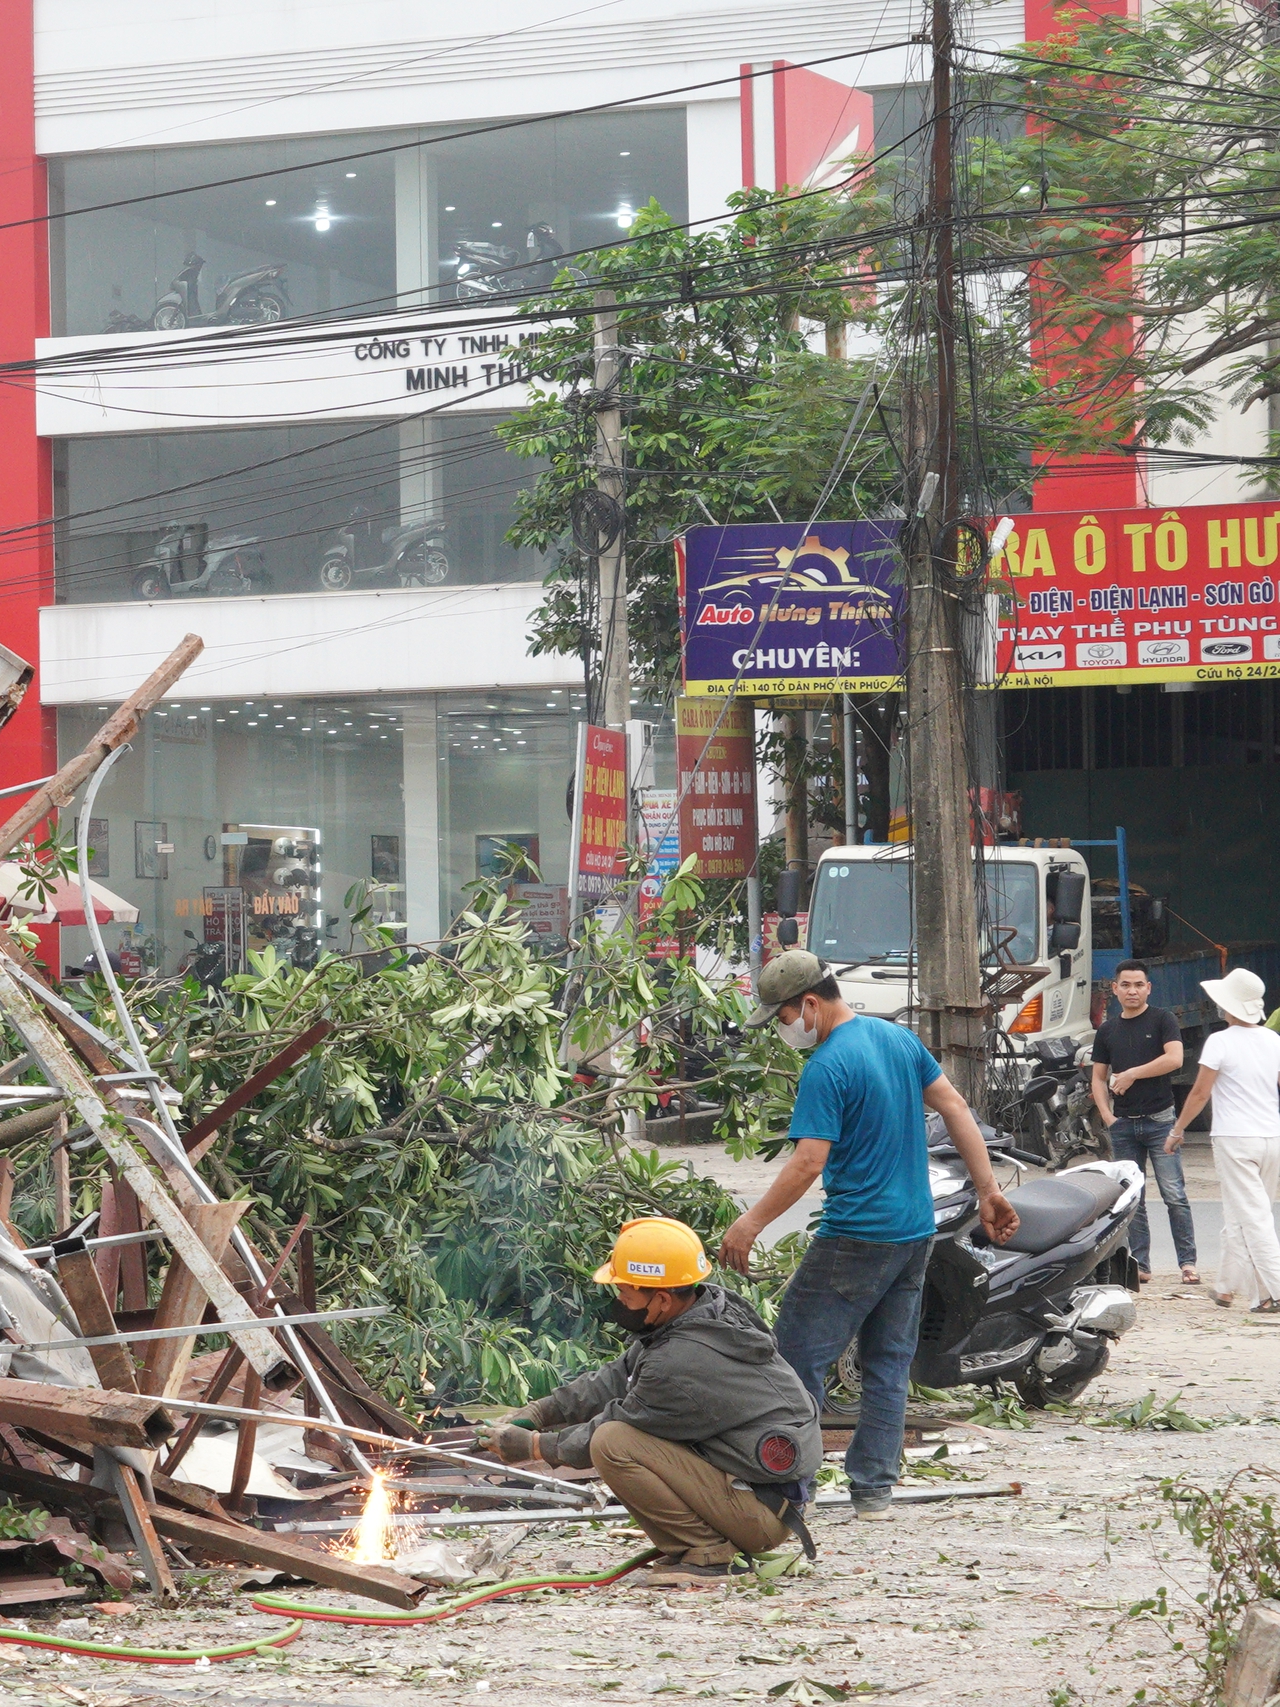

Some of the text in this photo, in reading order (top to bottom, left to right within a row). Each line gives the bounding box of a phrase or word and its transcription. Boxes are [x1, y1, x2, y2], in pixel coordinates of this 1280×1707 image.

[354, 334, 509, 361] CÔNG TY TNHH
[406, 365, 468, 391] MINH
[1073, 515, 1106, 575] Ô
[1123, 511, 1188, 573] TÔ
[1030, 586, 1073, 618] ĐIỆN
[1090, 584, 1133, 615] ĐIỆN
[1138, 585, 1188, 613] LẠNH
[1205, 582, 1244, 606] SƠN
[1249, 575, 1274, 604] GÒ
[696, 603, 755, 625] Auto
[996, 615, 1277, 642] THAY THẾ PHỤ TÙNG
[732, 641, 861, 670] CHUYÊN:
[1211, 643, 1241, 655] Ford
[707, 684, 725, 695] ĐỊA
[752, 683, 769, 692] 140
[772, 677, 786, 692] TỔ
[789, 679, 810, 691] DÂN
[860, 679, 888, 690] PHÚC
[1197, 667, 1223, 679] Cứu
[1226, 667, 1242, 680] hộ
[254, 889, 275, 915] ĐẨY
[629, 1262, 662, 1275] DELTA
